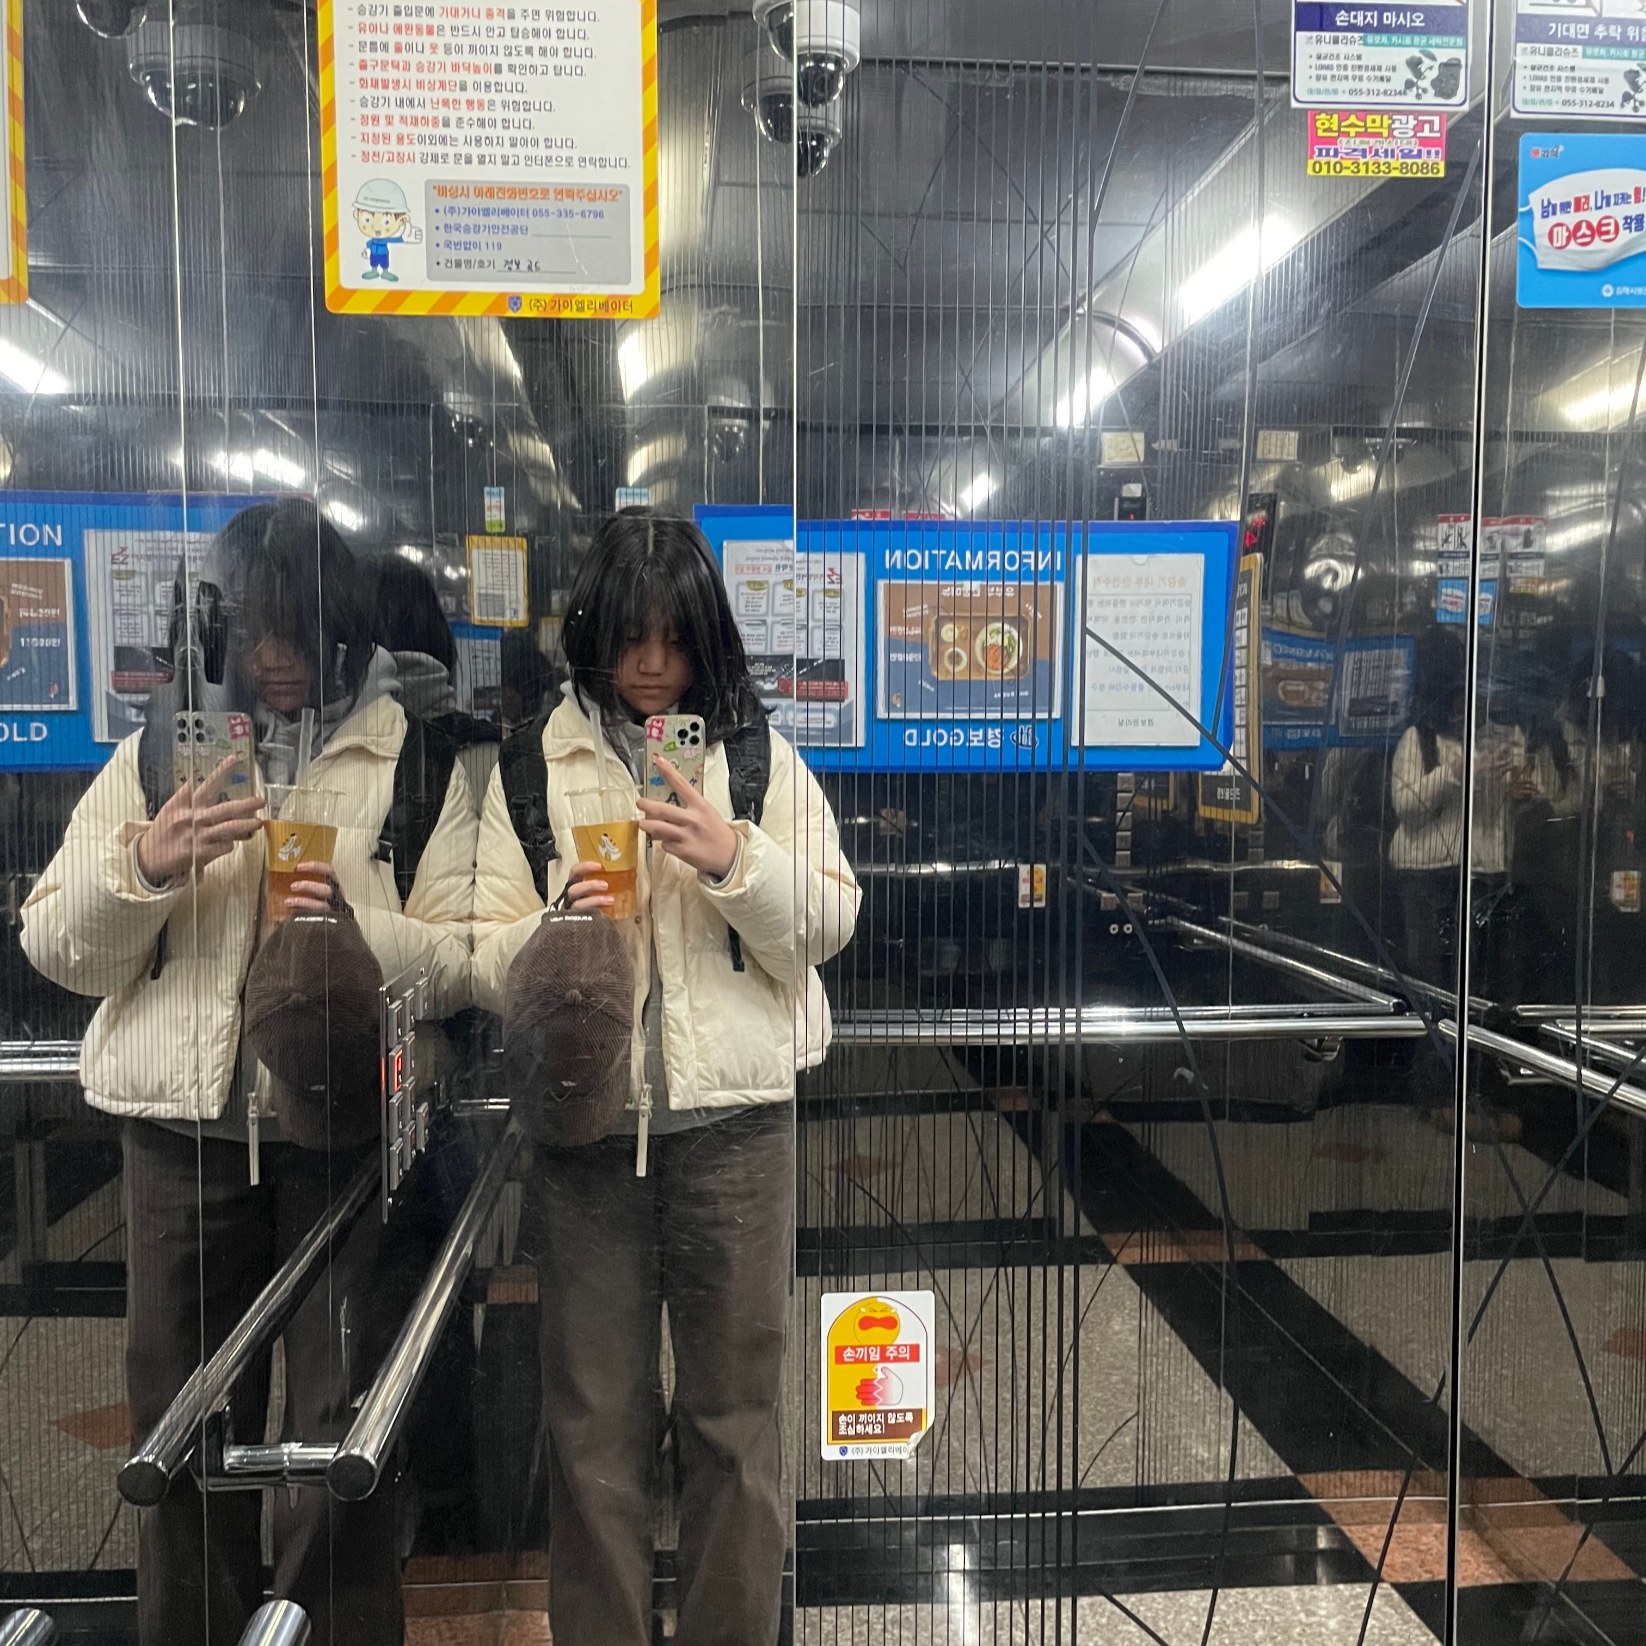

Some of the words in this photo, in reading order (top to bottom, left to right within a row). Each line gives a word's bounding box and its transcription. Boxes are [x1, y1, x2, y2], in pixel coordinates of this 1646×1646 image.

[357, 4, 389, 17] 승강기
[393, 4, 435, 18] 출입문에
[439, 6, 481, 19] 기대거나
[485, 7, 516, 20] 충격을
[521, 8, 541, 21] 주면
[545, 9, 599, 22] 위험합니다.
[1335, 10, 1378, 27] 손대지
[1383, 12, 1425, 28] 마시오
[358, 21, 389, 35] 유아나
[393, 22, 445, 37] 애완동물은
[450, 24, 481, 37] 반드시
[485, 26, 505, 39] 안고
[510, 26, 551, 39] 탑승해야
[556, 27, 589, 40] 합니다.
[1548, 23, 1590, 39] 기대면
[1594, 24, 1622, 40] 추락
[358, 40, 389, 53] 문틈에
[443, 43, 463, 56] 등이
[468, 44, 499, 57] 끼이지
[504, 44, 534, 58] 않도록
[538, 45, 558, 58] 해야
[563, 46, 596, 59] 합니다.
[415, 60, 446, 73] 승강기
[451, 62, 502, 75] 바닥높이를
[507, 64, 548, 77] 확인하고
[553, 64, 586, 77] 탑니다.
[359, 78, 411, 92] 화재발생시
[416, 79, 468, 93] 비상계단을
[473, 80, 527, 94] 이용합니다.
[359, 96, 390, 109] 승강기
[395, 96, 426, 110] 내에서
[430, 98, 461, 111] 난폭한
[465, 98, 496, 112] 행동은
[501, 100, 555, 113] 위험합니다.
[360, 114, 379, 127] 정원
[385, 114, 394, 127] 및
[399, 115, 450, 129] 적재하중을
[455, 116, 497, 130] 준수해야
[502, 118, 535, 130] 합니다.
[1315, 113, 1441, 138] 현수막광고
[360, 132, 391, 146] 지정된
[396, 133, 458, 147] 용도이외에는
[463, 135, 504, 148] 사용하지
[509, 135, 539, 149] 말아야
[544, 136, 577, 150] 합니다.
[361, 150, 415, 165] 정전/고장시
[419, 151, 450, 165] 강제로
[454, 152, 473, 166] 문을
[477, 153, 496, 166] 열지
[501, 154, 520, 167] 말고
[524, 154, 574, 168] 인터폰으로
[578, 156, 630, 170] 연락합니다.
[1312, 161, 1440, 175] 010-3133-8086
[532, 208, 604, 219] 055-335-6796
[443, 222, 529, 236] 한국승강기안전공단
[1552, 218, 1616, 247] 마스크
[444, 240, 481, 252] 국번없이
[485, 240, 502, 251] 119
[529, 298, 547, 312] (주)
[842, 1347, 880, 1362] 손끼임
[885, 1346, 910, 1360] 주의
[838, 1413, 856, 1424] 손이
[859, 1412, 884, 1424] 끼이지
[888, 1412, 913, 1424] 않도록
[852, 1446, 863, 1455] (주)
